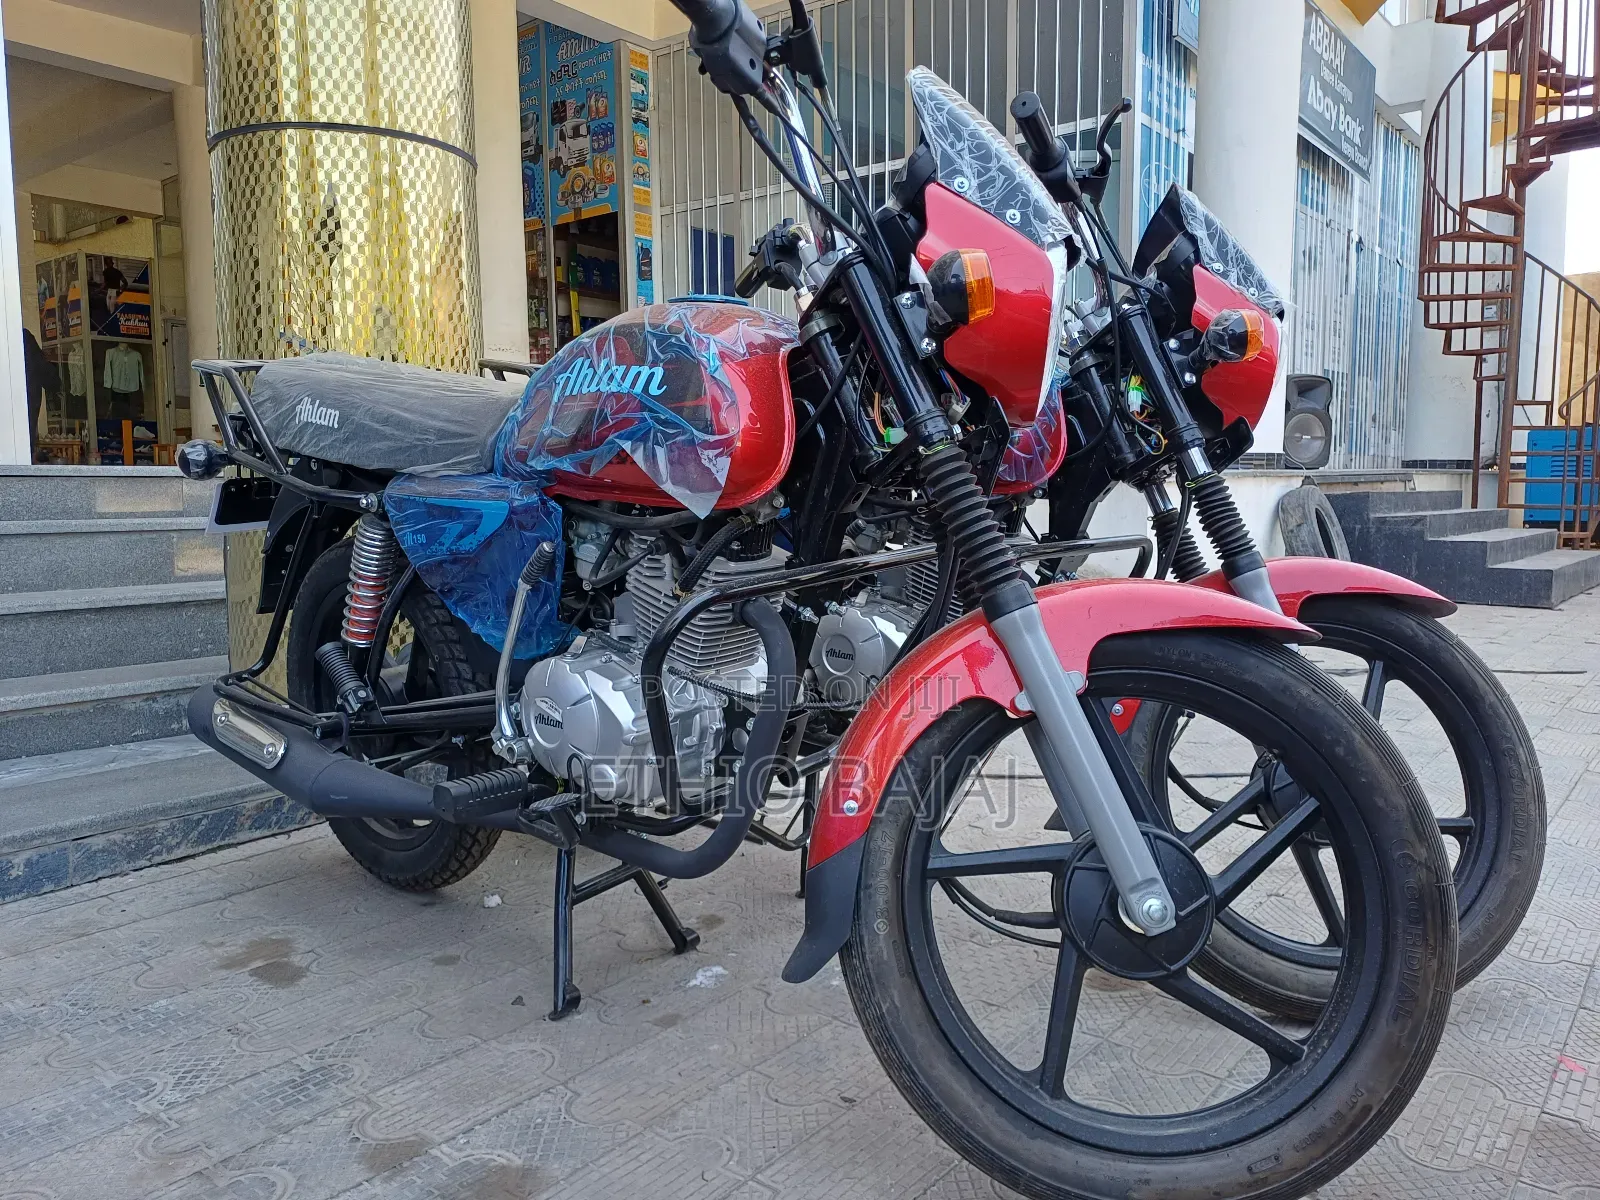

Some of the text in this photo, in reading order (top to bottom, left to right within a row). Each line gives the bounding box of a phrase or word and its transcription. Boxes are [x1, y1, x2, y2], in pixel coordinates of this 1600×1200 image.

[1309, 11, 1346, 77] ABBAAY
[1307, 74, 1362, 147] Abay Bank
[553, 357, 668, 403] Ahlam
[295, 396, 340, 429] Ahlam
[825, 647, 854, 661] Ahlam
[534, 712, 564, 730] Ahlam
[1392, 878, 1424, 1022] CORDIAL
